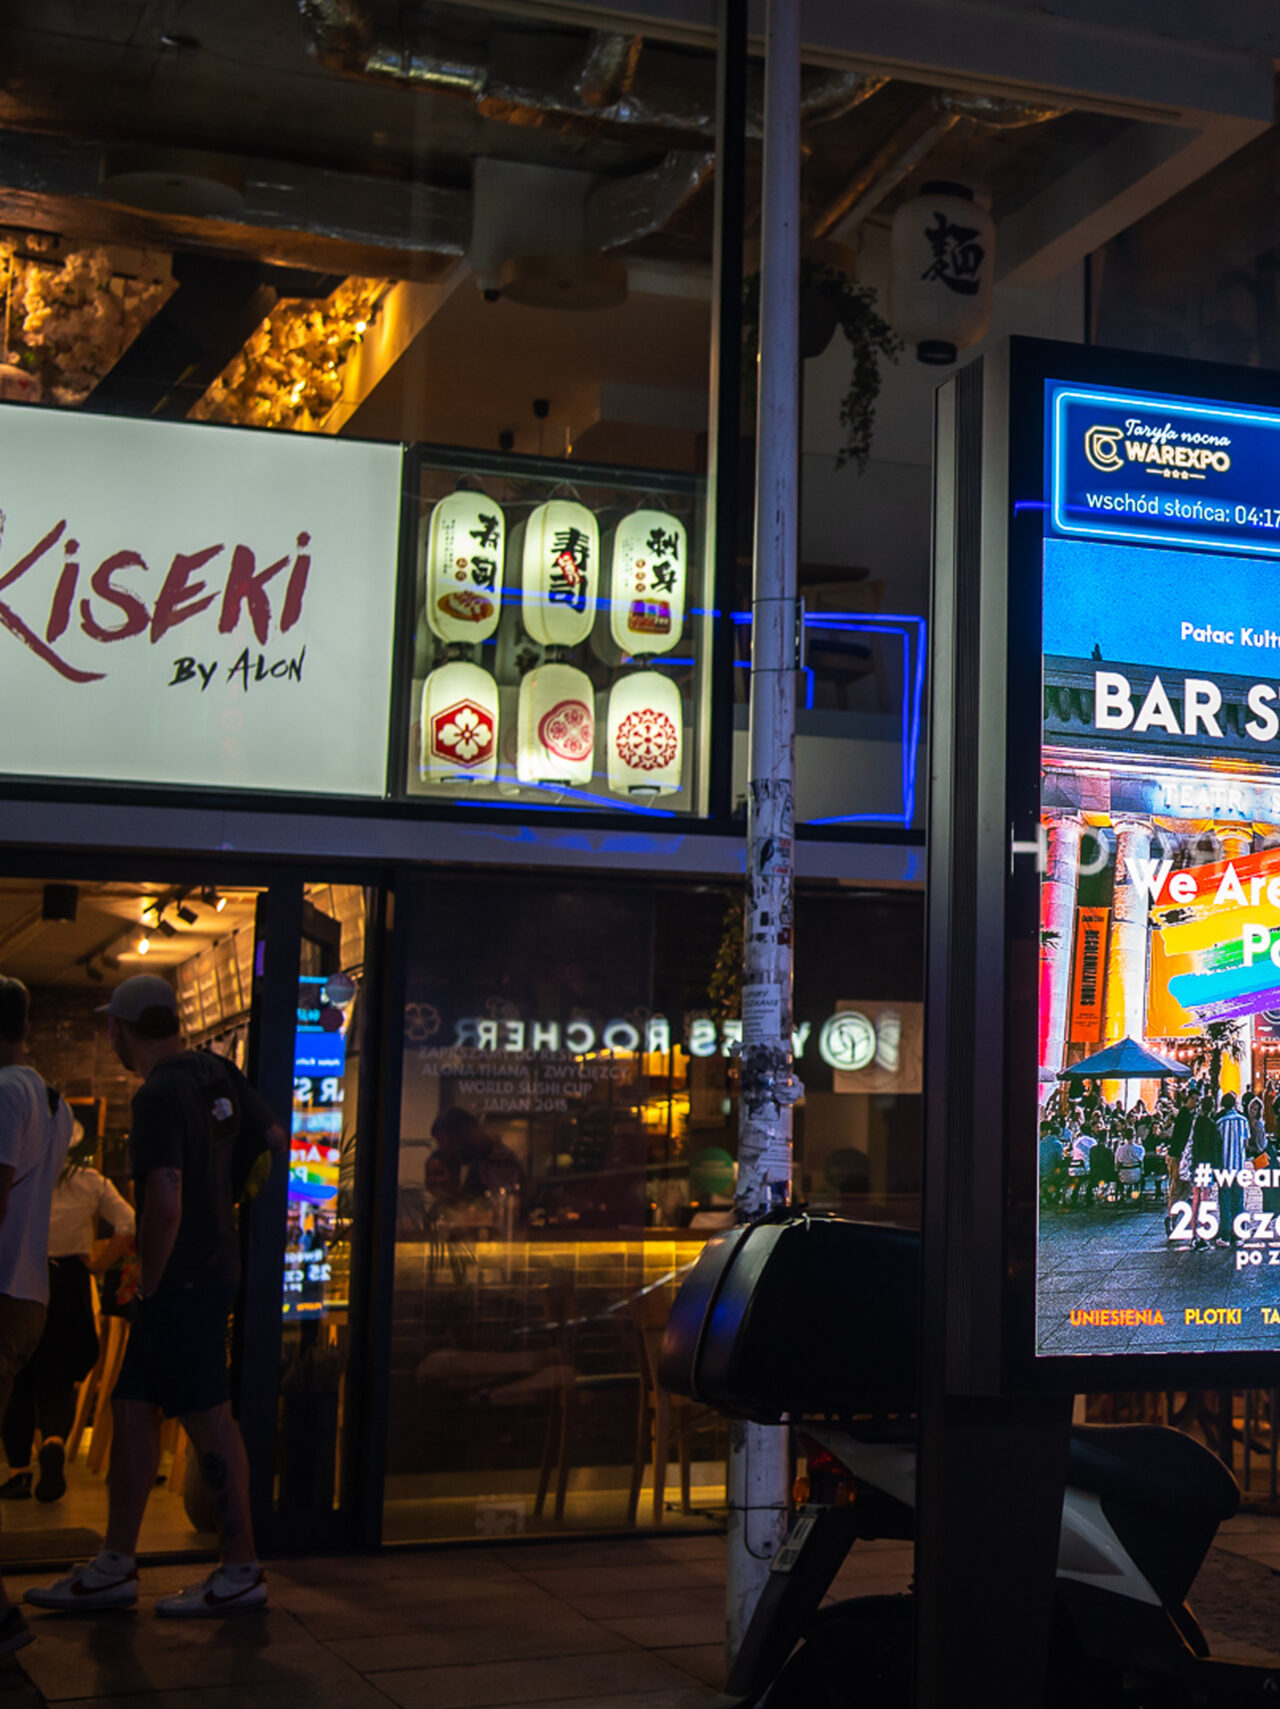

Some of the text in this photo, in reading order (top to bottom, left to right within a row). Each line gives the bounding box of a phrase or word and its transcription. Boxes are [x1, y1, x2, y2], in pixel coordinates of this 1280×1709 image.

[1124, 418, 1231, 447] Taryfa nocna
[1124, 440, 1231, 472] WAREXPO
[1086, 493, 1159, 515] wschód
[1164, 499, 1230, 523] słońca:
[1181, 621, 1235, 644] Pałac
[226, 644, 307, 693] ALON
[1094, 671, 1224, 738] BAR
[1160, 783, 1246, 818] TEATR
[1124, 857, 1198, 906] We
[421, 1063, 476, 1077] ALONA
[458, 1079, 593, 1097] WORLD SUSHI CUP
[482, 1098, 530, 1114] JAPAN
[1168, 1201, 1220, 1240] 25
[1236, 1250, 1263, 1270] po
[1069, 1308, 1165, 1327] UNIESIENIA
[1184, 1308, 1243, 1325] PLOTKI
